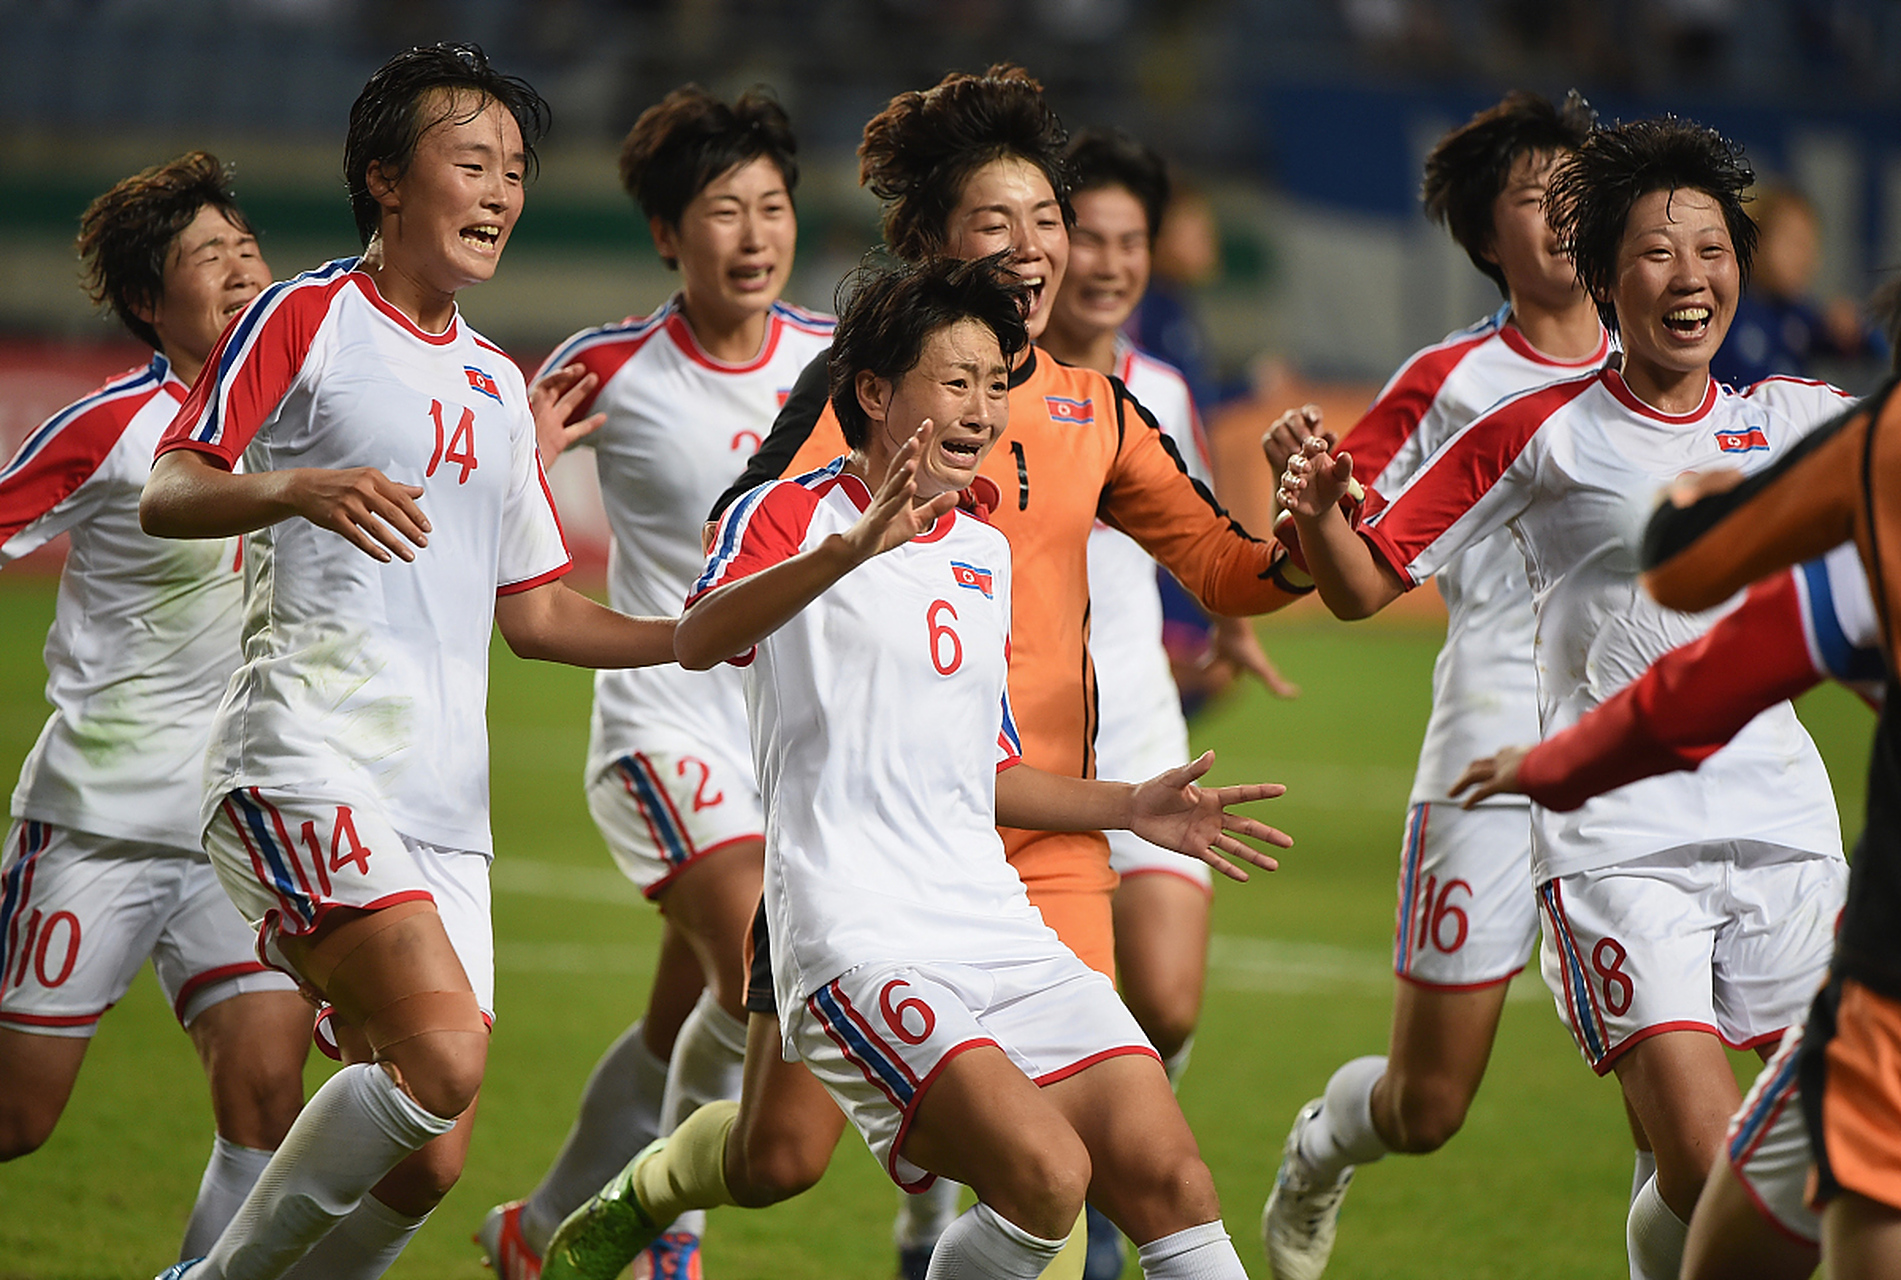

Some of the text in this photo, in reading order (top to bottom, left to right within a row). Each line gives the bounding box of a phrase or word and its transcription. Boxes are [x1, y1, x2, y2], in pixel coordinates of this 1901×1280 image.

[426, 398, 479, 485] 14
[1009, 440, 1029, 512] 1
[926, 599, 963, 676] 6
[677, 757, 724, 813] 2
[301, 805, 372, 898] 14
[14, 908, 82, 988] 10
[1417, 875, 1473, 954] 16
[878, 979, 936, 1045] 6
[1591, 937, 1634, 1017] 8
